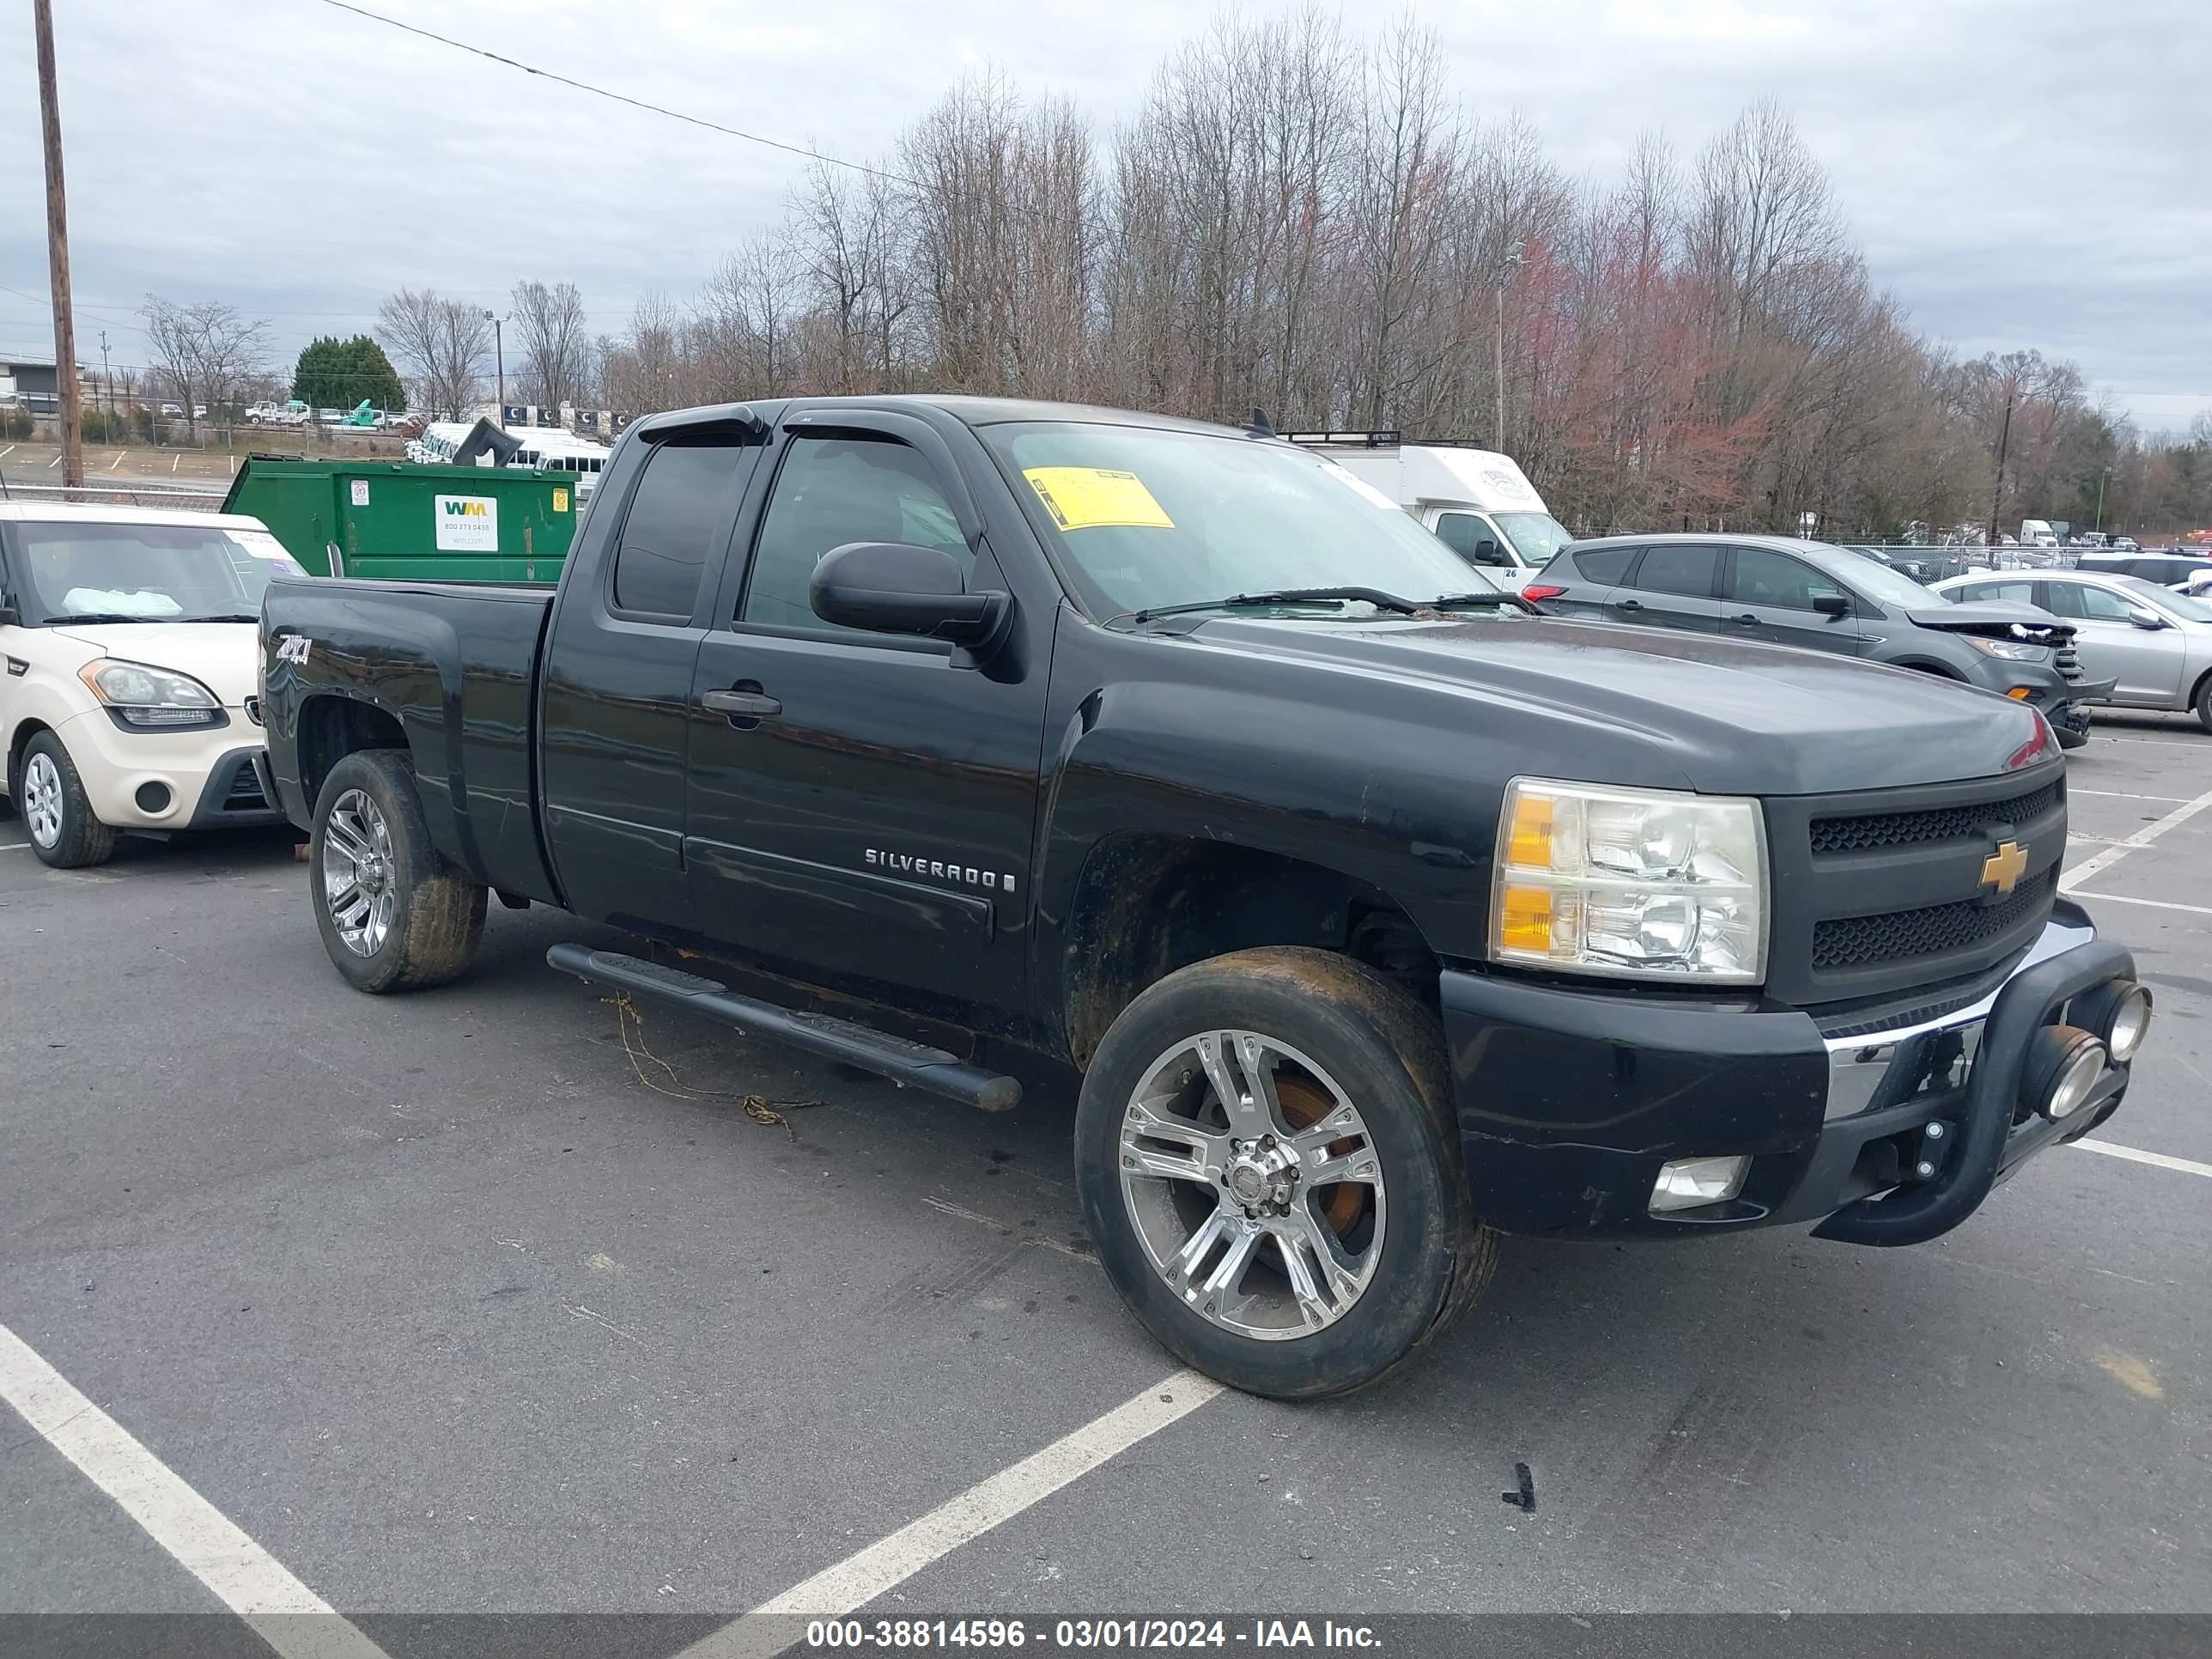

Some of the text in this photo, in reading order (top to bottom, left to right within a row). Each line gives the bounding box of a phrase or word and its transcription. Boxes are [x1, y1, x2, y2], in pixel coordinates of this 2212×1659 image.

[445, 501, 488, 516] WM
[1505, 568, 1516, 578] 26
[276, 634, 313, 659] Z71
[865, 848, 996, 887] SILVERADO
